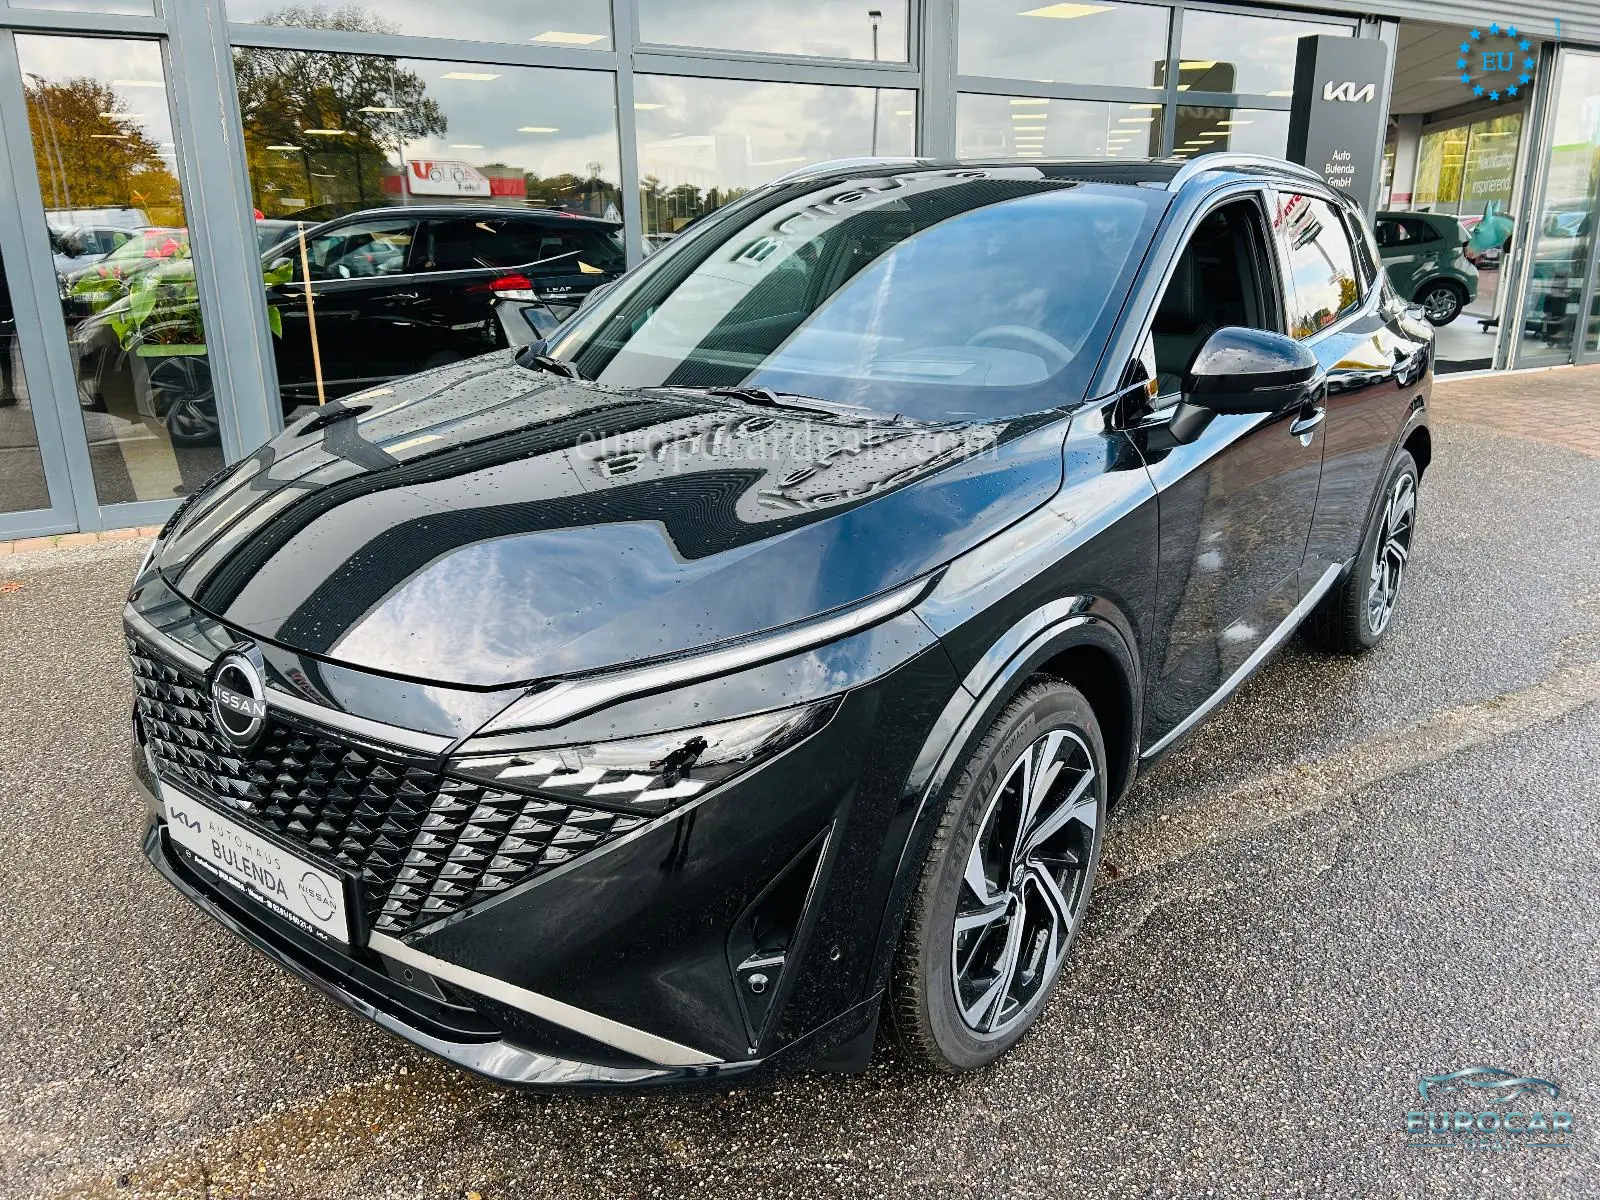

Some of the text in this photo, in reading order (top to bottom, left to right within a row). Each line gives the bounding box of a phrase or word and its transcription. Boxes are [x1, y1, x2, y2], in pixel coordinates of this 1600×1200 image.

[1323, 81, 1375, 102] KIA
[1325, 164, 1355, 174] Bulenda
[1332, 150, 1351, 161] Auto
[1328, 177, 1352, 187] GmbH
[212, 682, 265, 717] NISSAN
[170, 806, 202, 833] KIA
[209, 821, 281, 870] AUTOHAUS
[211, 838, 289, 900] BULENDA
[298, 882, 337, 911] NISSAN
